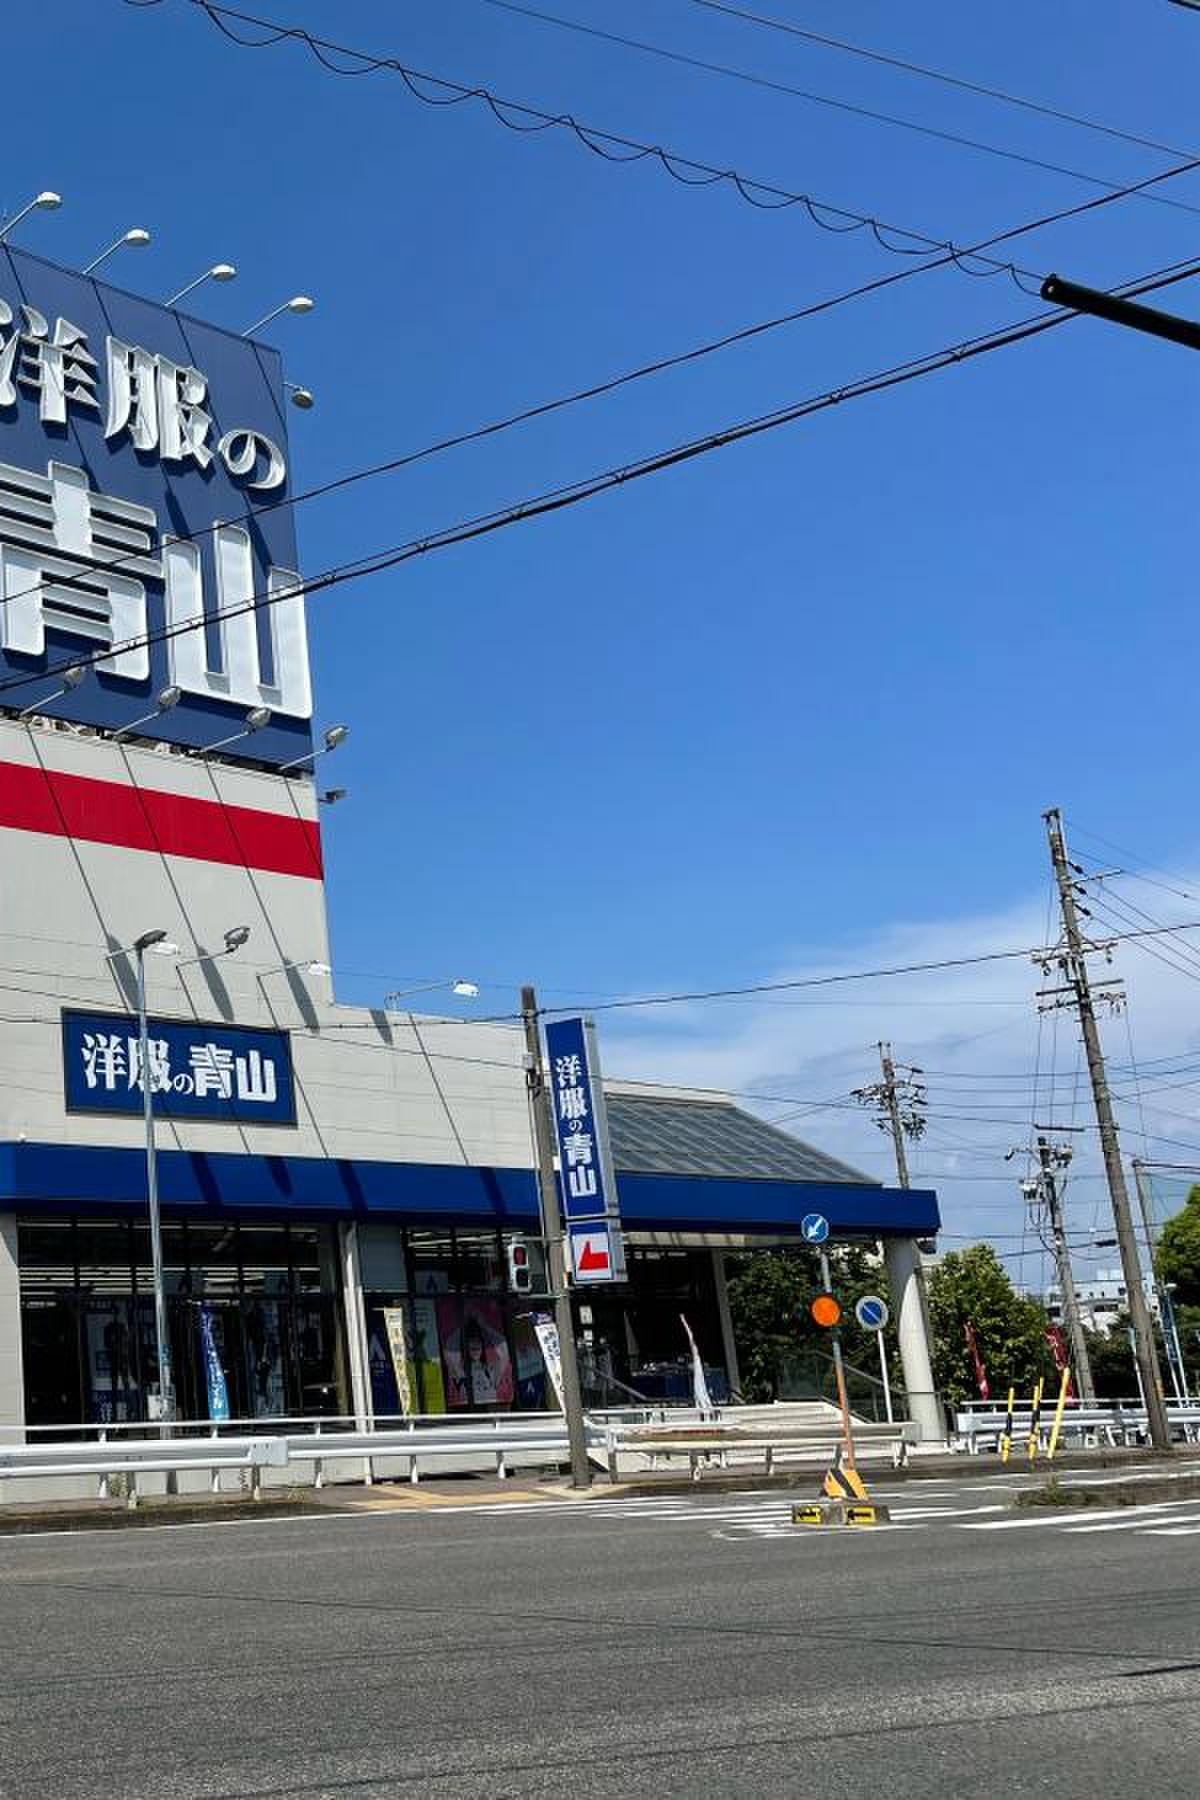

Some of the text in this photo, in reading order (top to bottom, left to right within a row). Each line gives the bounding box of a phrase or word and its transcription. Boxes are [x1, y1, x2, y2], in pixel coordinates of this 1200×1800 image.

[81, 1032, 278, 1102] 洋服の青山
[555, 1054, 597, 1198] 洋服の青山
